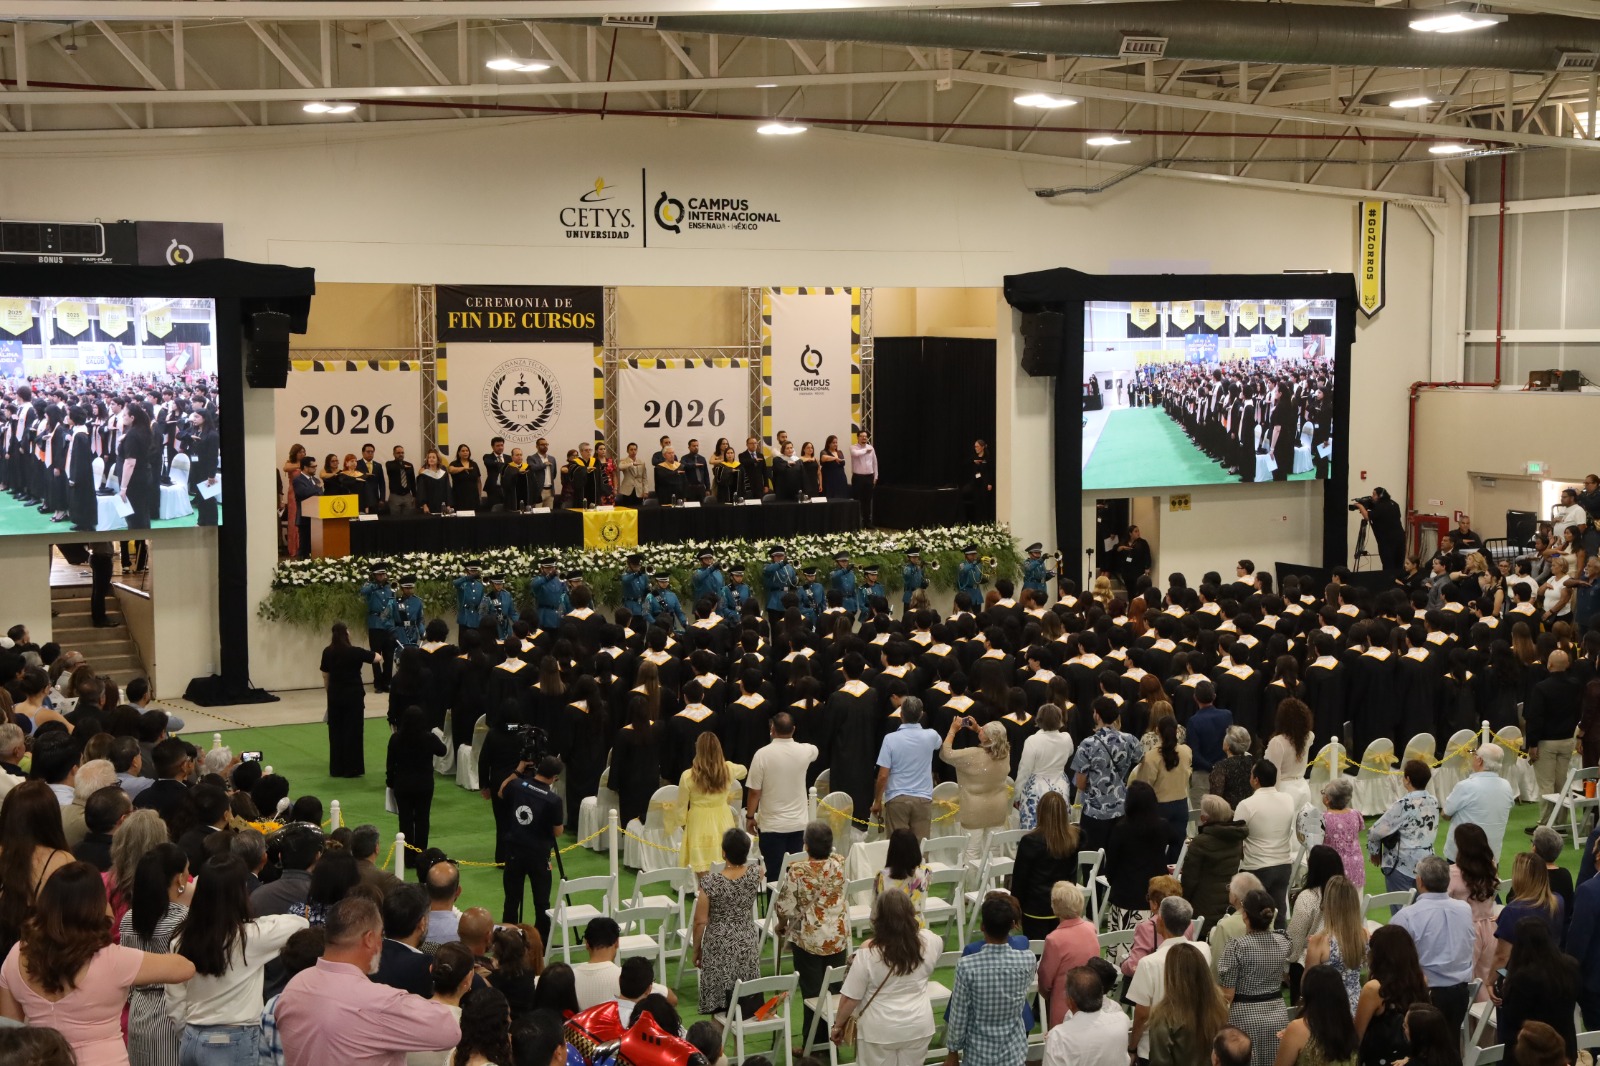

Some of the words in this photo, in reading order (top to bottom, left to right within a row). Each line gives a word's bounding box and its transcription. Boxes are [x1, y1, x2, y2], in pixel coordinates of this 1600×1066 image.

[688, 198, 749, 211] CAMPUS
[688, 211, 781, 222] INTERNACIONAL
[688, 222, 726, 230] ENSENADA
[566, 230, 630, 239] UNIVERSIDAD
[38, 256, 64, 264] BONUS
[466, 297, 549, 308] CEREMONIA
[554, 297, 573, 308] DE
[448, 311, 482, 329] FIN
[488, 311, 517, 329] DE
[521, 311, 596, 330] CURSOS
[793, 379, 830, 387] CAMPUS
[500, 399, 544, 412] CETYS
[299, 403, 395, 435] 2026
[643, 398, 726, 429] 2026
